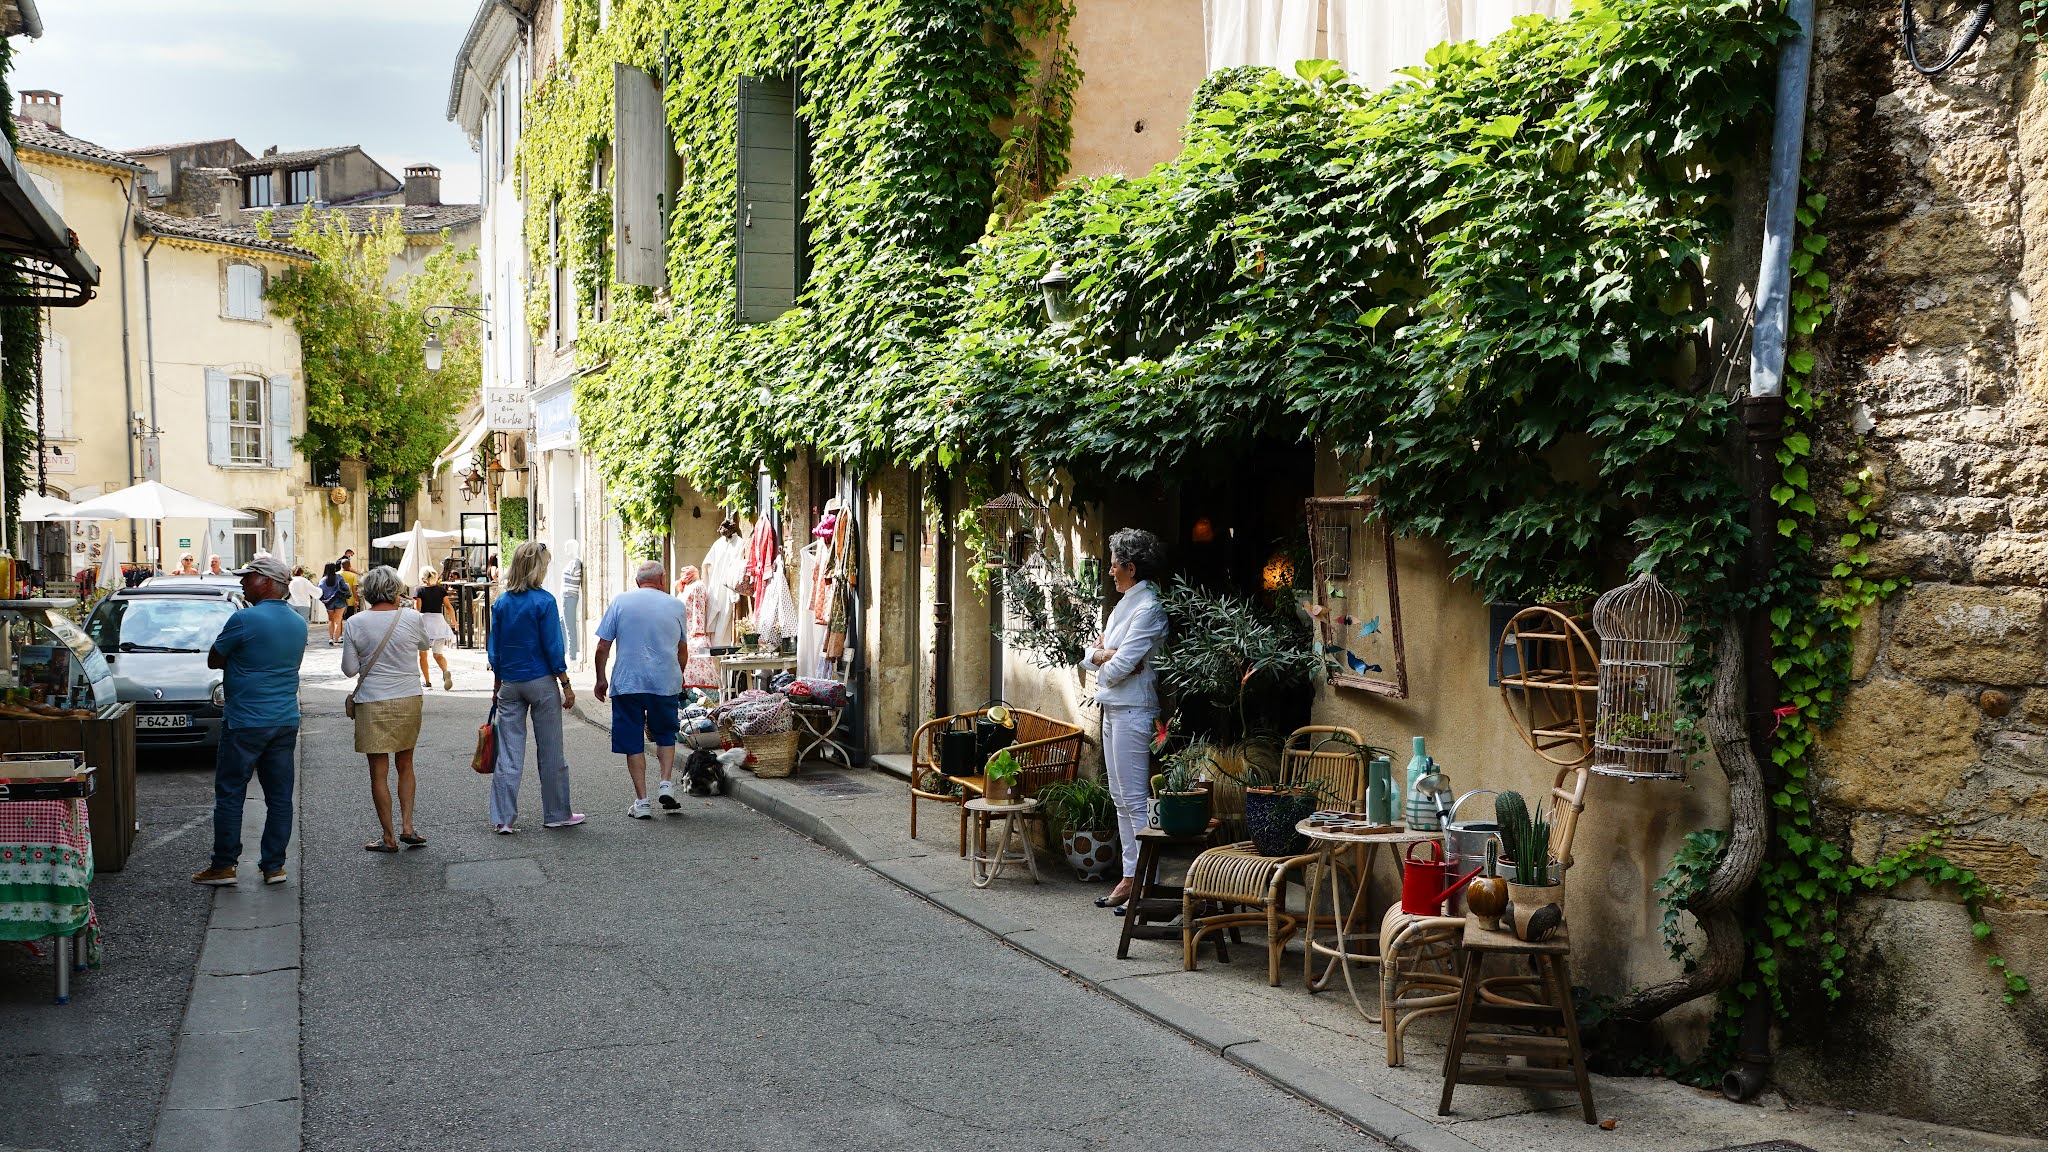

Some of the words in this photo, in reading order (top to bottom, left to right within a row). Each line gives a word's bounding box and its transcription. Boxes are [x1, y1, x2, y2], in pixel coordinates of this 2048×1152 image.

[491, 393, 503, 403] Le
[506, 393, 525, 403] Blé
[494, 413, 522, 425] Herbe
[136, 716, 186, 727] F-642-AB
